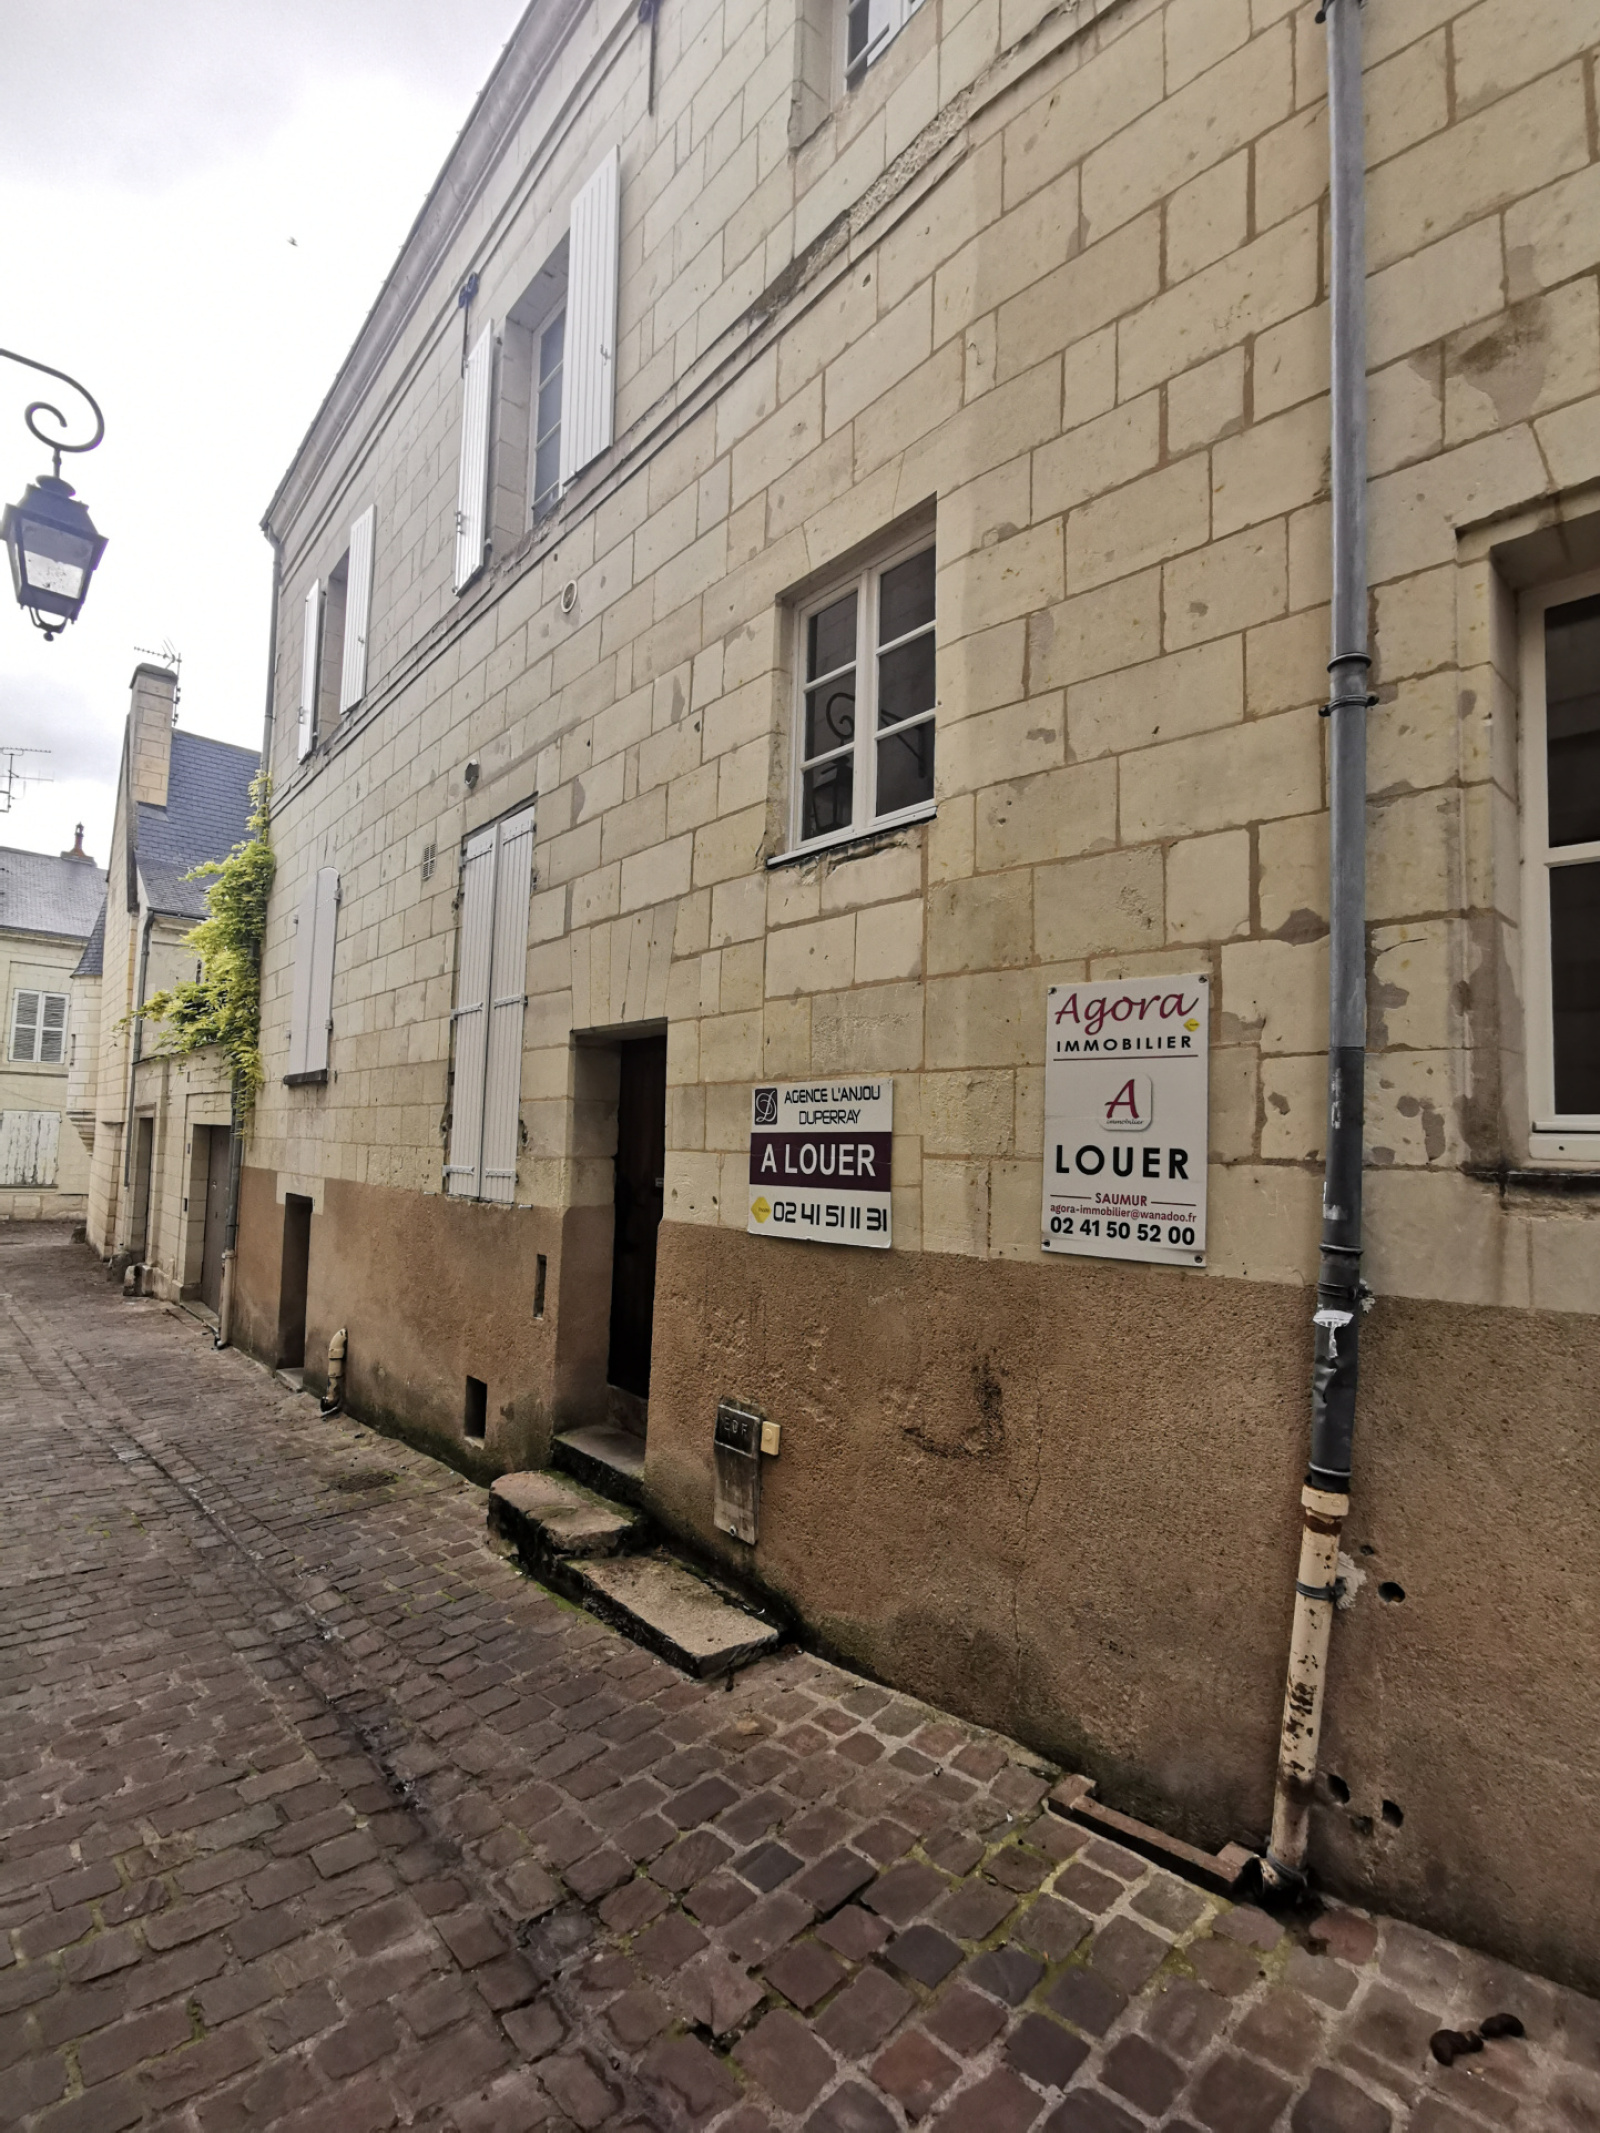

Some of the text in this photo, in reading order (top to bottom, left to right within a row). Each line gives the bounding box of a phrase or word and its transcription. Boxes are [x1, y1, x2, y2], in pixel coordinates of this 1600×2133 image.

[1055, 992, 1199, 1035] Agora
[1056, 1035, 1192, 1053] IMMOBILIER
[784, 1085, 881, 1104] AGENCE L'ANJOU
[1104, 1078, 1140, 1119] A
[799, 1109, 861, 1125] DUPERRAY
[760, 1143, 876, 1177] A LOUER
[1055, 1144, 1189, 1180] LOUER
[1050, 1203, 1197, 1223] agora-immobilier@wanadoo.fr
[1095, 1192, 1148, 1207] SAUMUR
[773, 1201, 888, 1232] 02 41 51 11 31
[1050, 1216, 1195, 1246] 02 41 50 52 00
